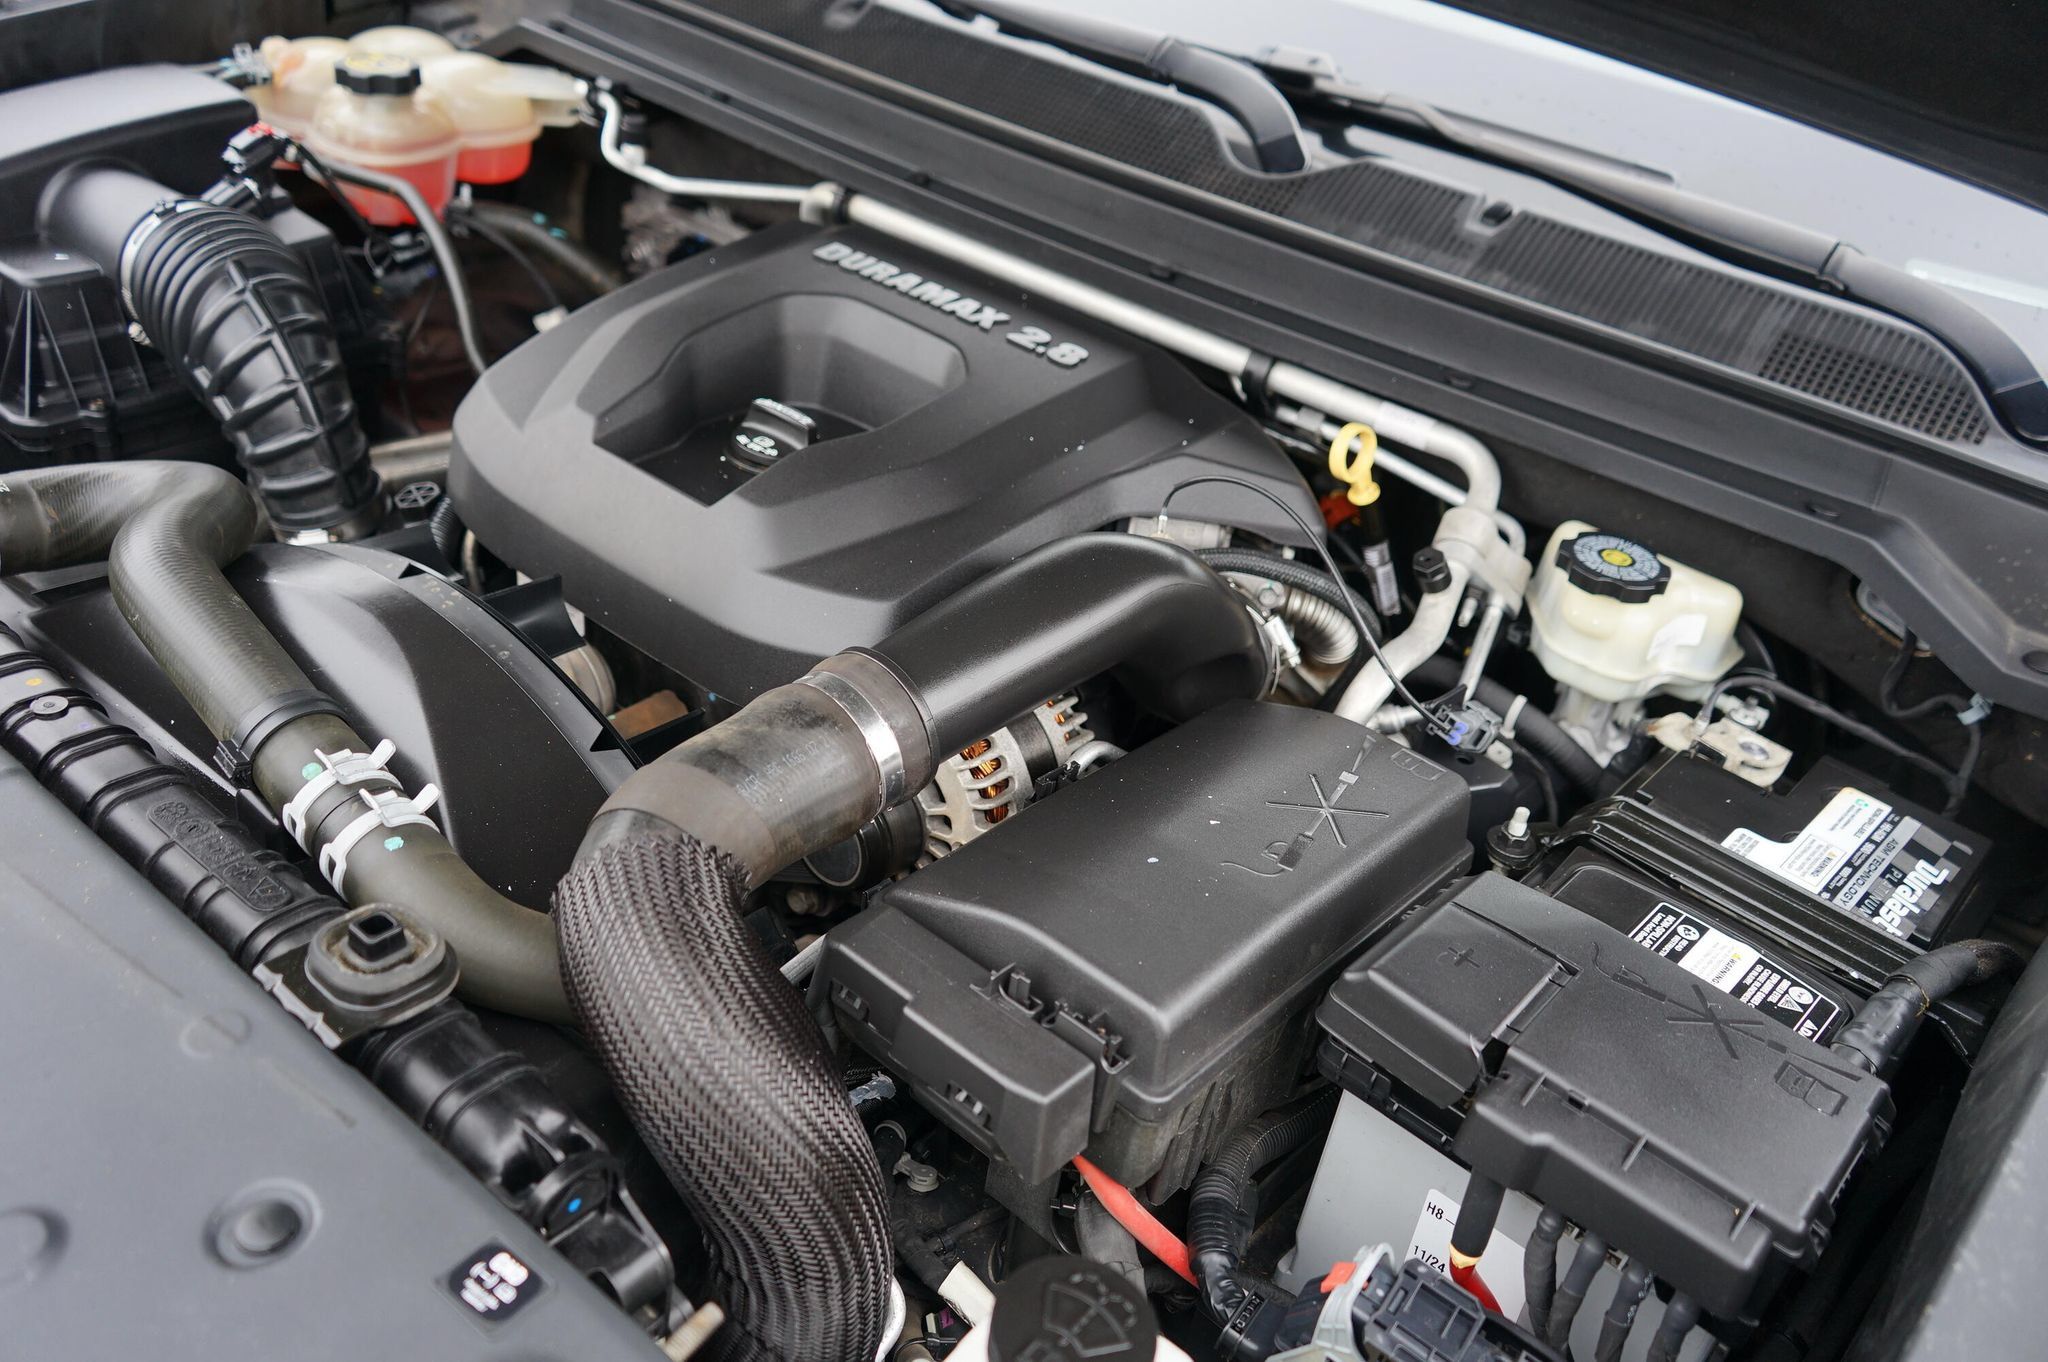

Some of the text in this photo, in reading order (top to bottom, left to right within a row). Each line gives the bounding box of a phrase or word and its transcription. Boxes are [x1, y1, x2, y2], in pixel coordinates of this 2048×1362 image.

[812, 241, 1089, 366] DURAMAX 2.8
[1882, 838, 1899, 857] AGM
[1841, 853, 1889, 906] TECHNOLOGY
[1859, 867, 1903, 918] PLATINUM
[1872, 859, 1950, 936] Duralast
[1640, 914, 1676, 948] NON-SPILLAB
[1413, 1245, 1446, 1273] 11/24
